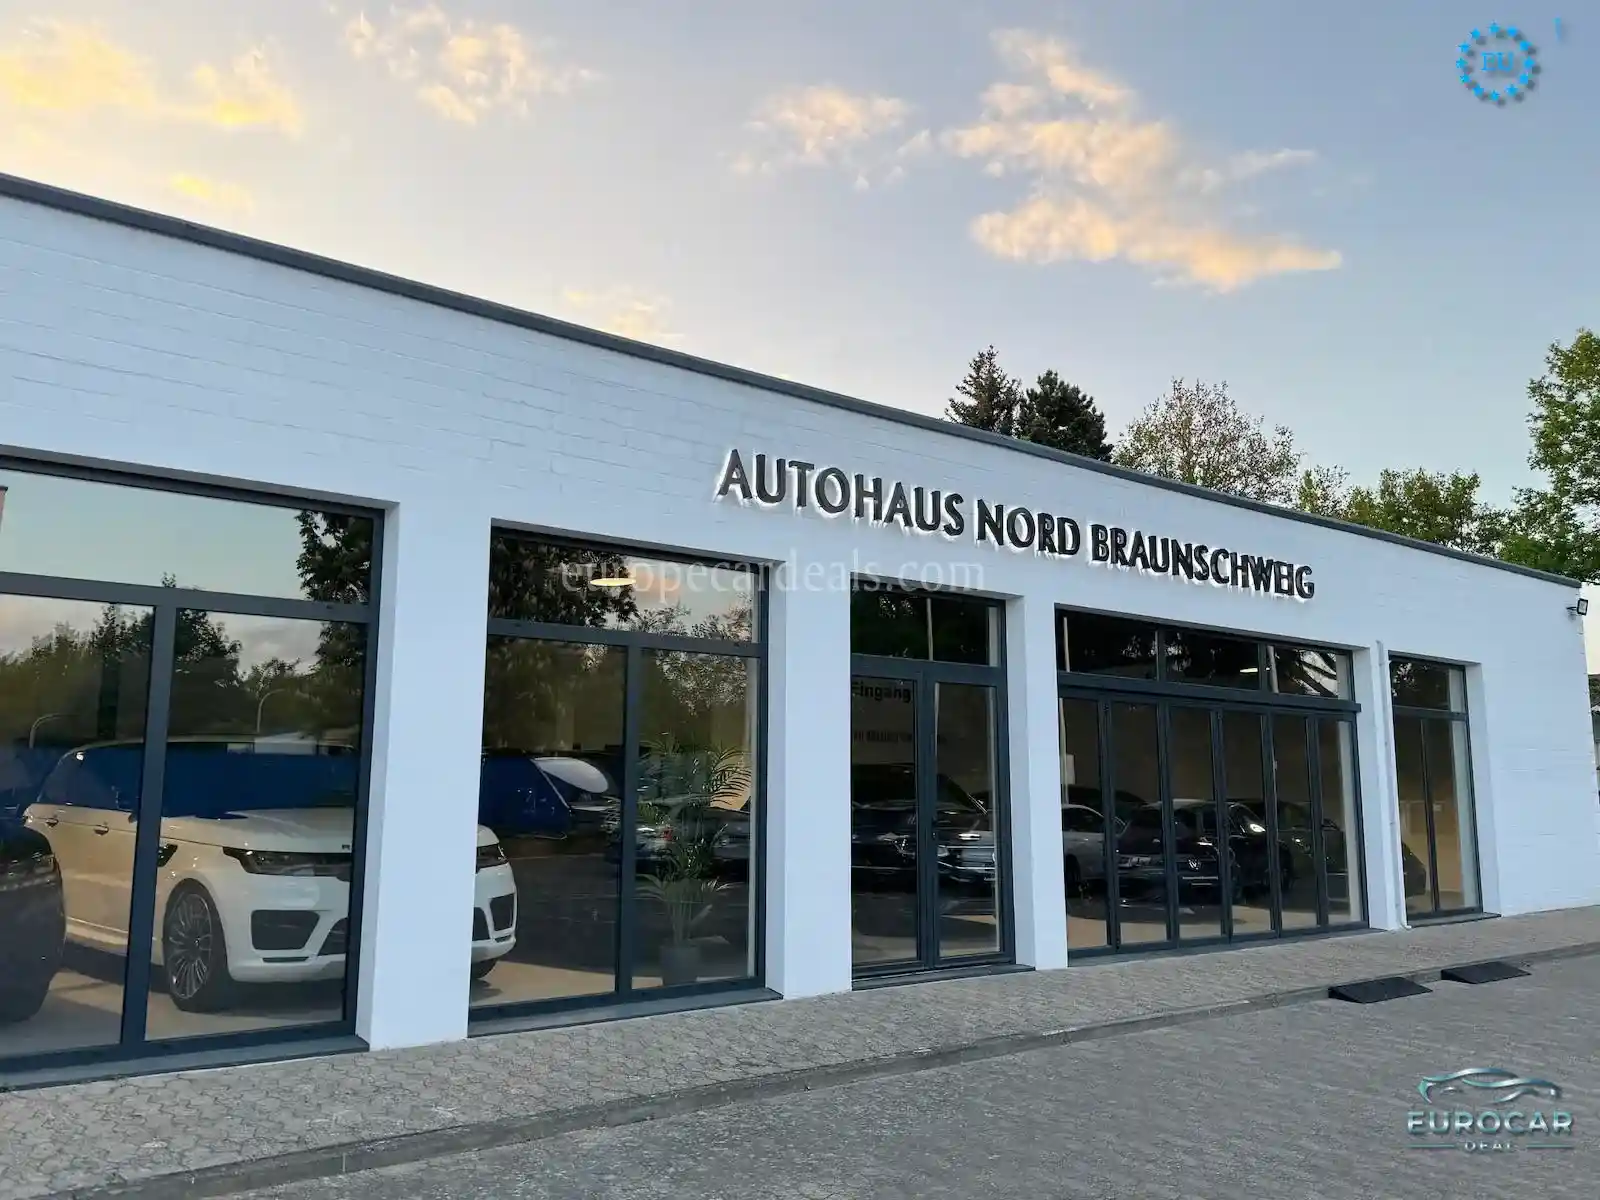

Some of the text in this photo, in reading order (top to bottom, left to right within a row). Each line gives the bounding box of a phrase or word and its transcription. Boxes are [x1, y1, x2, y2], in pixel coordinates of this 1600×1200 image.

[718, 449, 1315, 600] AUTOHAUS NORD BRAUNSCHWEIG
